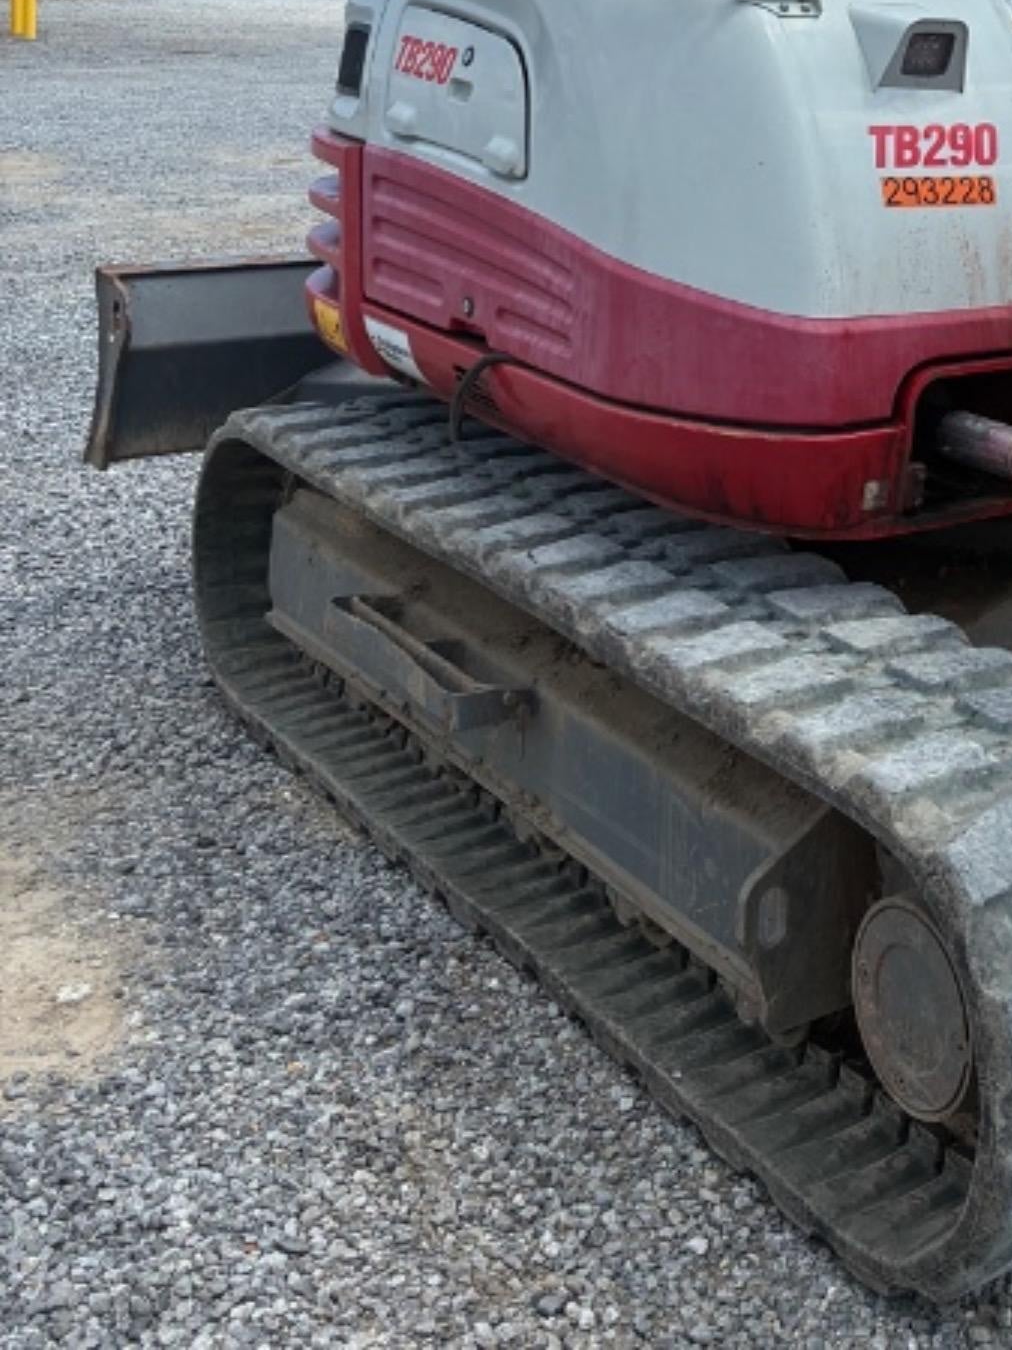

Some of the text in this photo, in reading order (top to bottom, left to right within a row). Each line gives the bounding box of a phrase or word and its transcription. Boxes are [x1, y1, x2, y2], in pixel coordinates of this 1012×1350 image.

[395, 34, 459, 85] TB290
[868, 122, 998, 168] TB290
[883, 176, 996, 207] 293228
